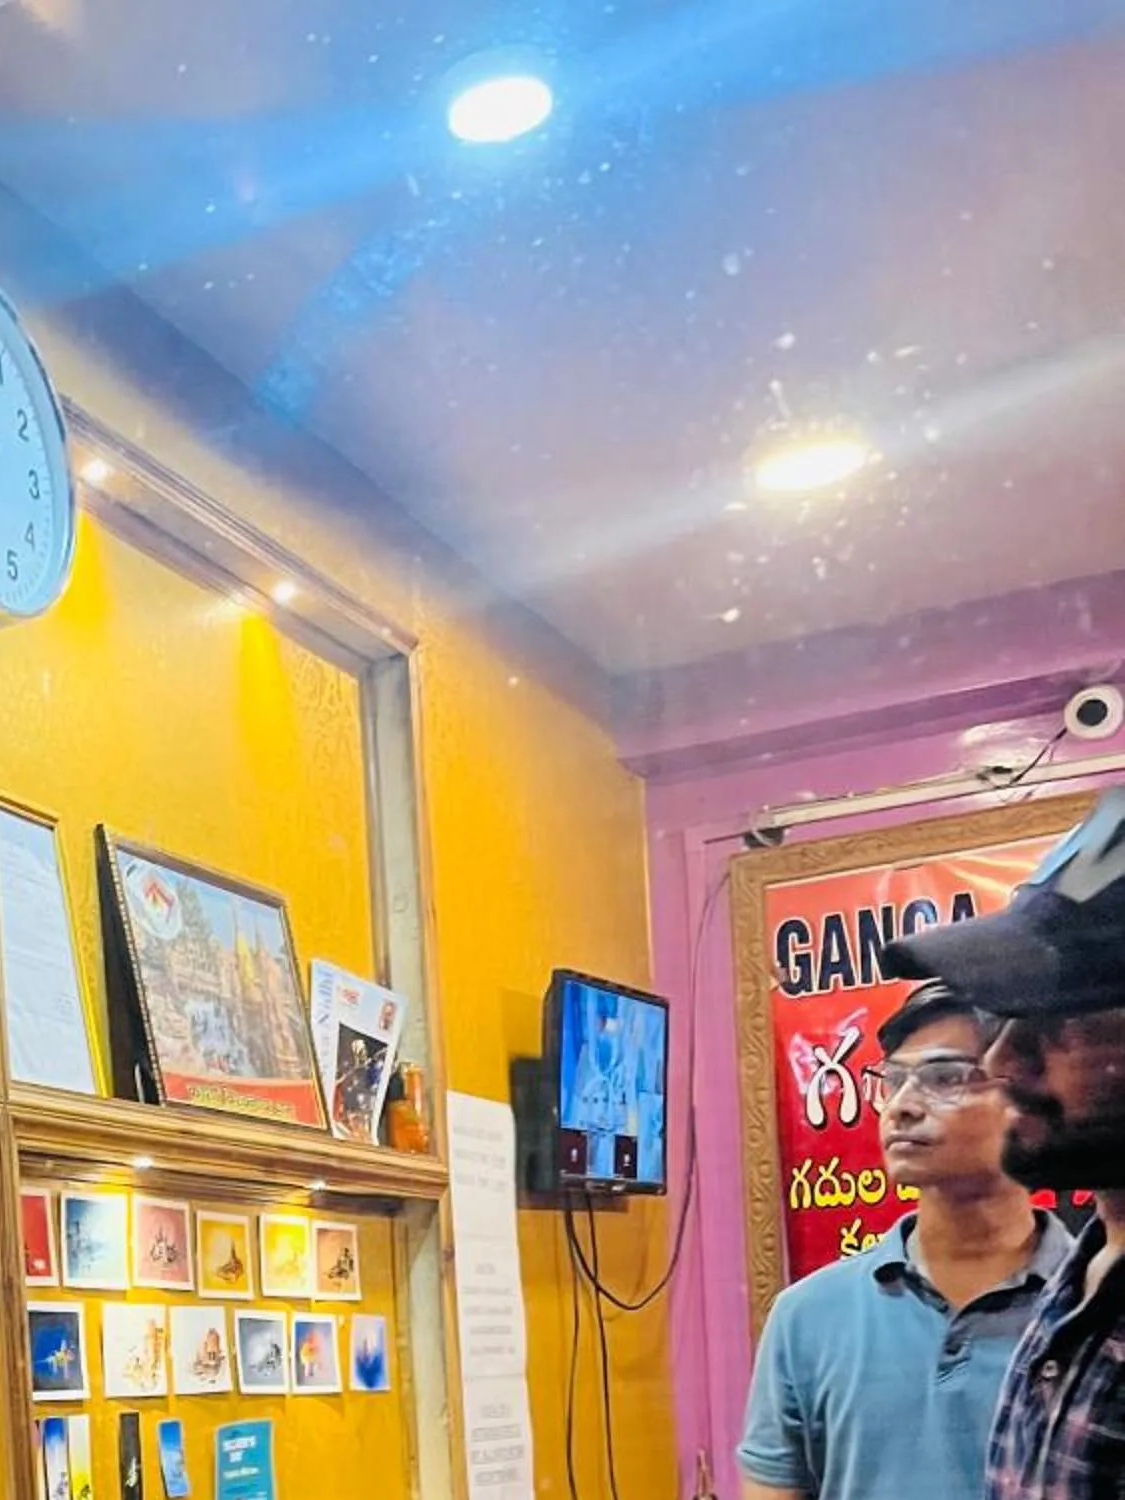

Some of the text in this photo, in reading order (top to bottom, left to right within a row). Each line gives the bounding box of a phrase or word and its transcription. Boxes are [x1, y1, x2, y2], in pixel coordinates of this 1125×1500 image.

[17, 408, 30, 443] 2
[28, 469, 41, 500] 3
[24, 521, 36, 551] 4
[6, 549, 19, 581] 5
